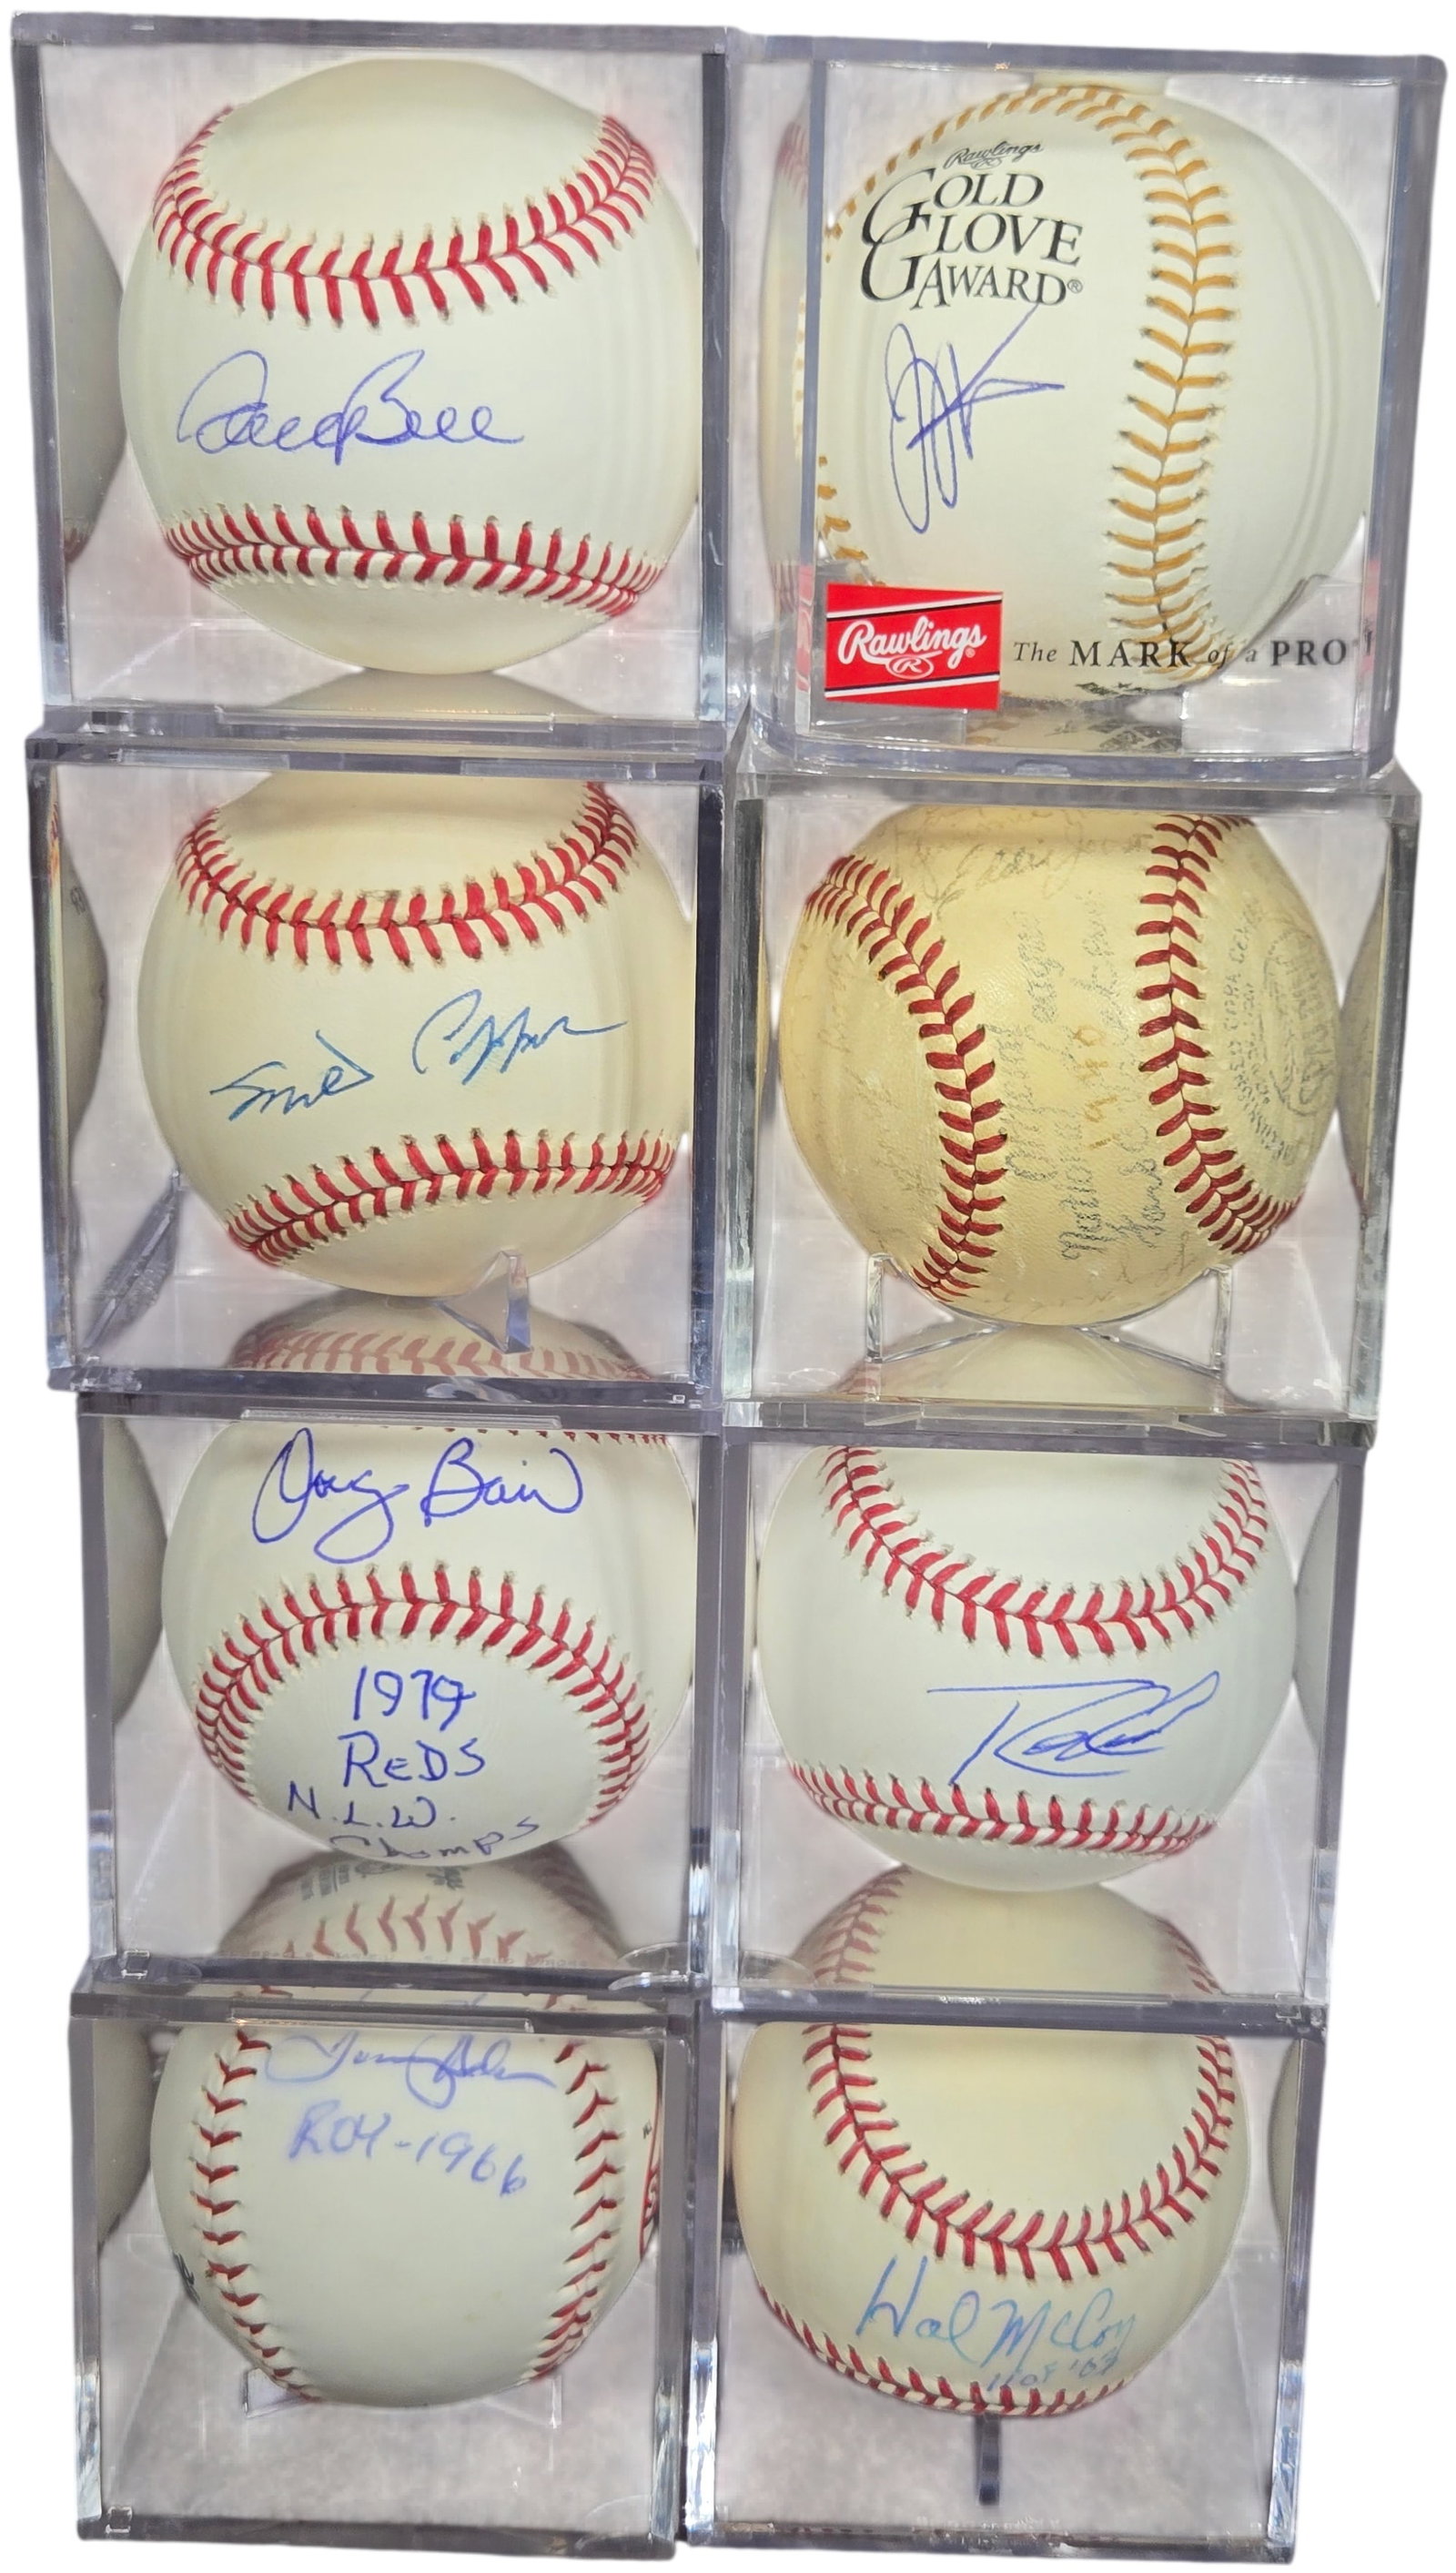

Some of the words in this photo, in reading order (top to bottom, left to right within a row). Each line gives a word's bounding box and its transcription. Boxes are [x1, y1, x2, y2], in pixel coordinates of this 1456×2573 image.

[943, 140, 1044, 169] Rawlings
[862, 167, 1044, 246] GOLD
[861, 212, 1083, 302] GLOVE
[1012, 640, 1057, 663] The
[1069, 639, 1193, 668] MARK
[1208, 641, 1229, 670] of
[1244, 649, 1258, 664] a
[1270, 639, 1347, 667] PRO
[352, 1666, 477, 1732] 1979
[855, 2254, 979, 2365] Hal
[980, 2287, 1136, 2372] McCoy
